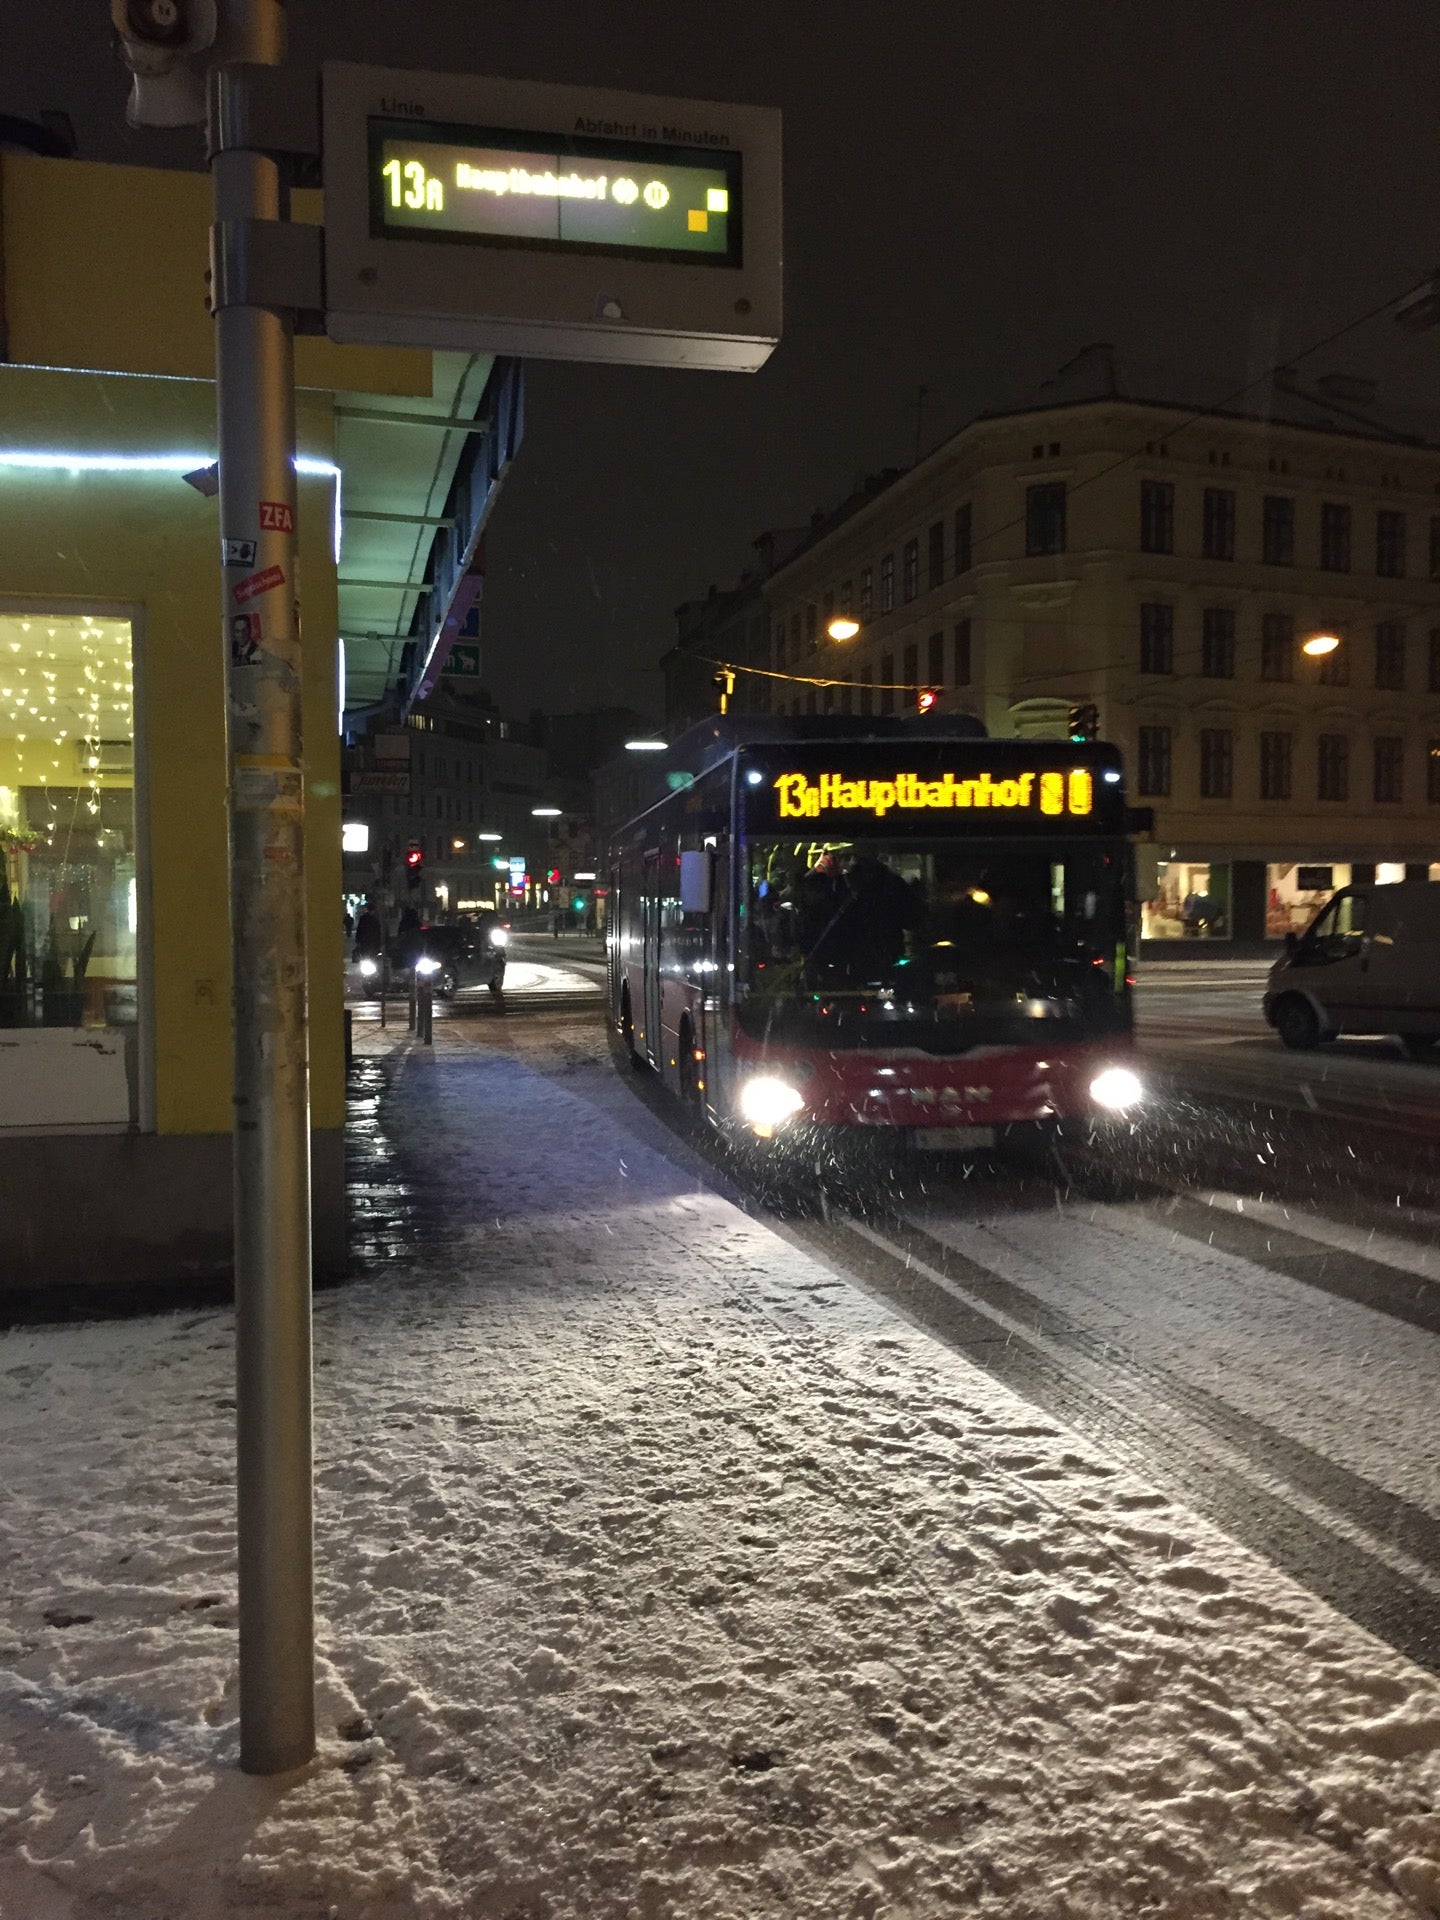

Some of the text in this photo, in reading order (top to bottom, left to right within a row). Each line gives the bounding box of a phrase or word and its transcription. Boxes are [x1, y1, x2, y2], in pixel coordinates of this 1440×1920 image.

[380, 98, 425, 116] Linie
[573, 116, 731, 147] Abfahrt in Minuten
[382, 159, 443, 211] 13A
[455, 163, 607, 201] Hauptbahnhof
[262, 505, 293, 530] ZFA
[820, 773, 1036, 816] Hauptbahnhof
